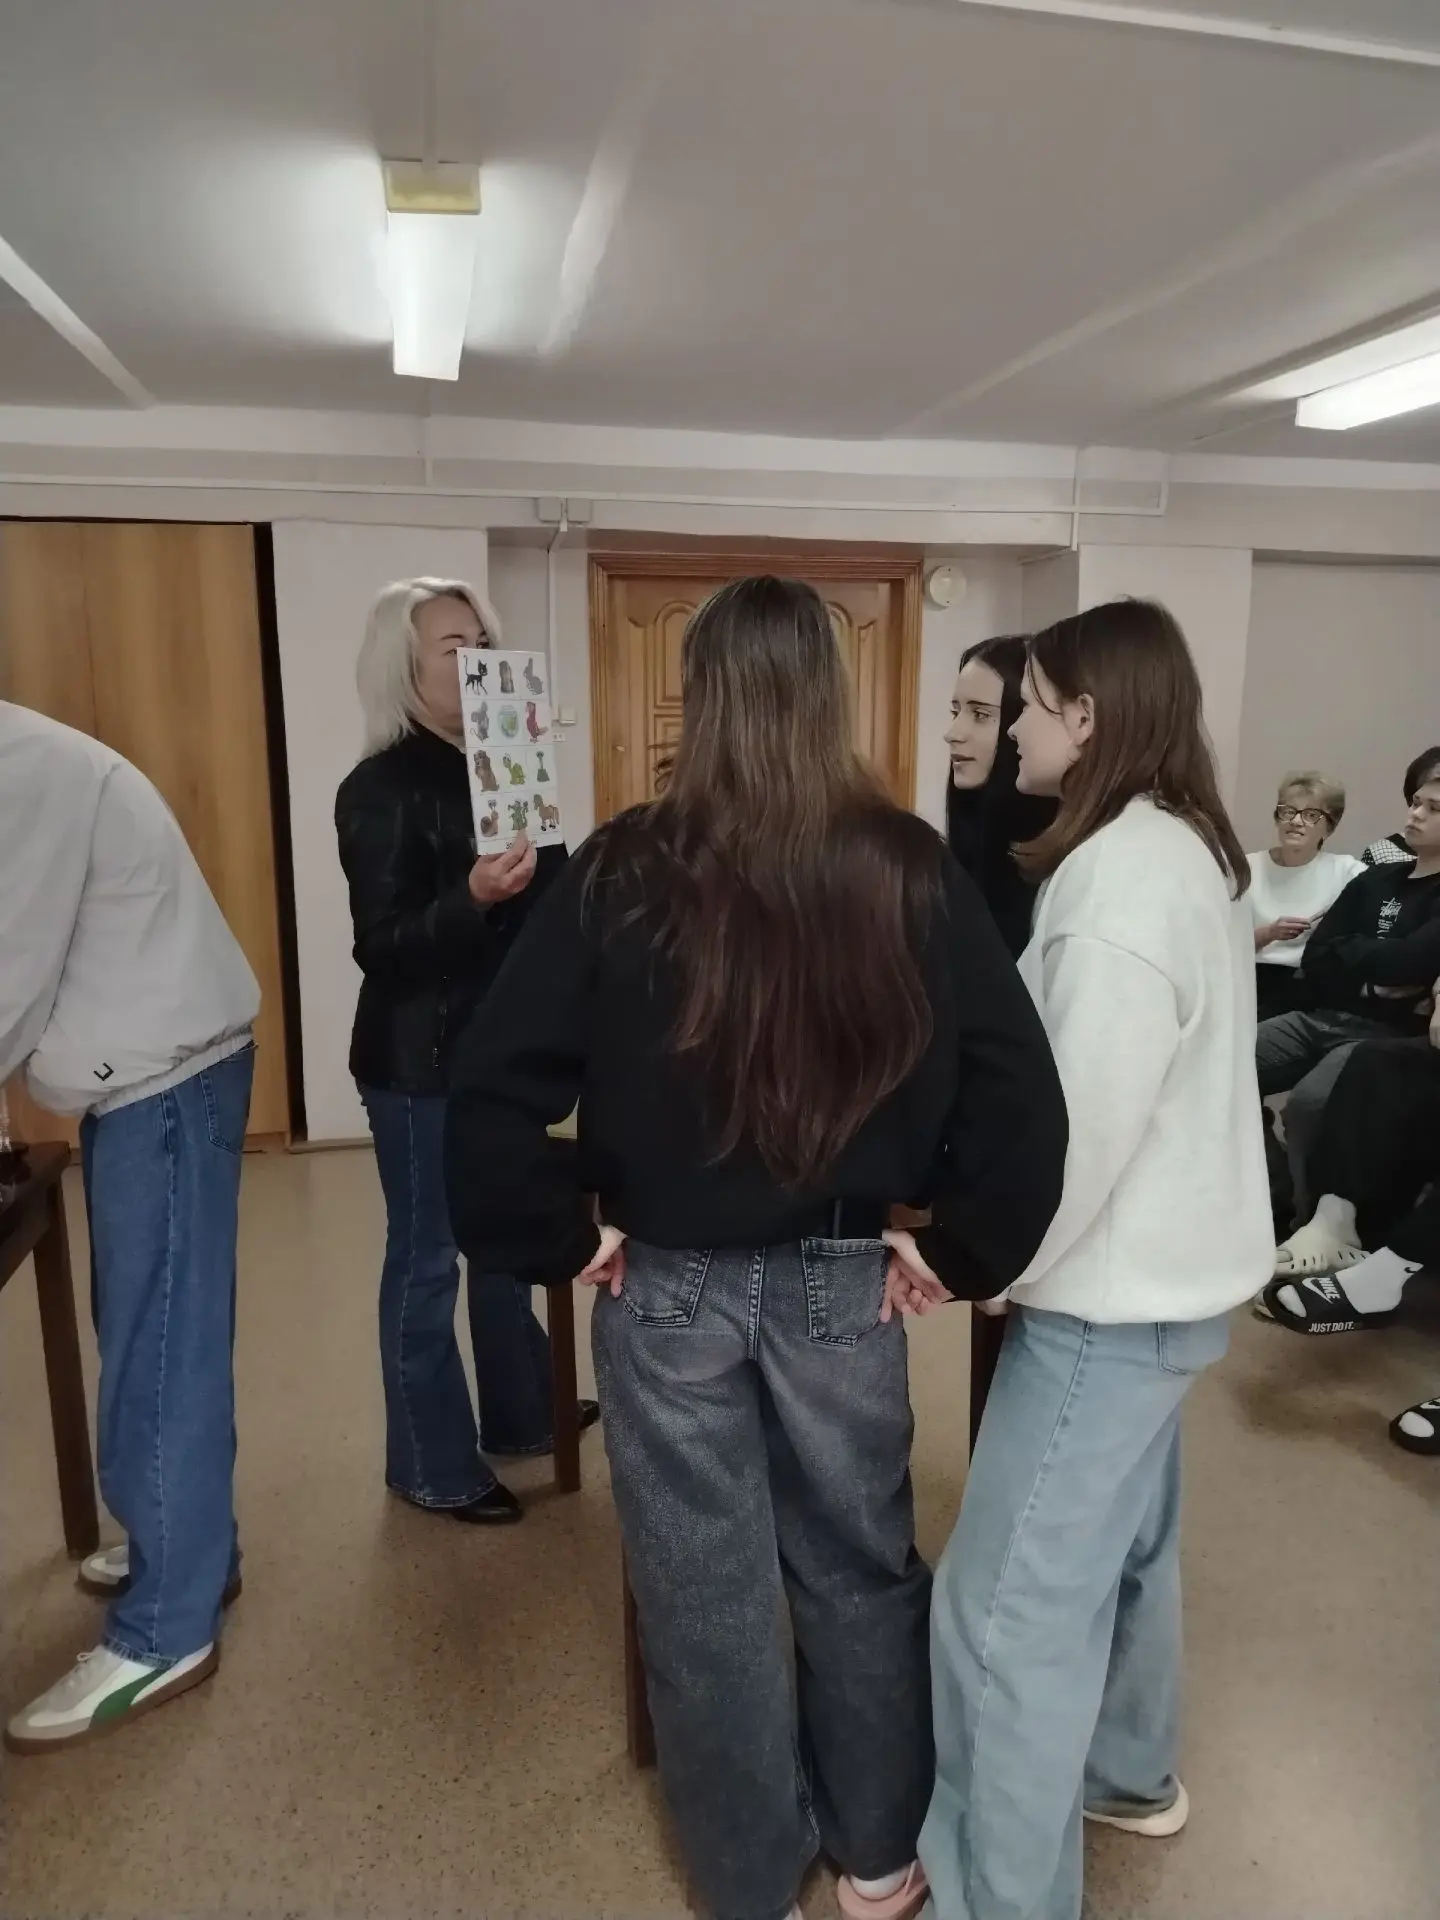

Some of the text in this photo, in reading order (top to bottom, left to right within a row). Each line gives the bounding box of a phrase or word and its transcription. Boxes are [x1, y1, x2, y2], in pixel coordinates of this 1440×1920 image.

[1317, 1277, 1341, 1299] NIKE
[1308, 1321, 1354, 1333] JUST DO IT.
